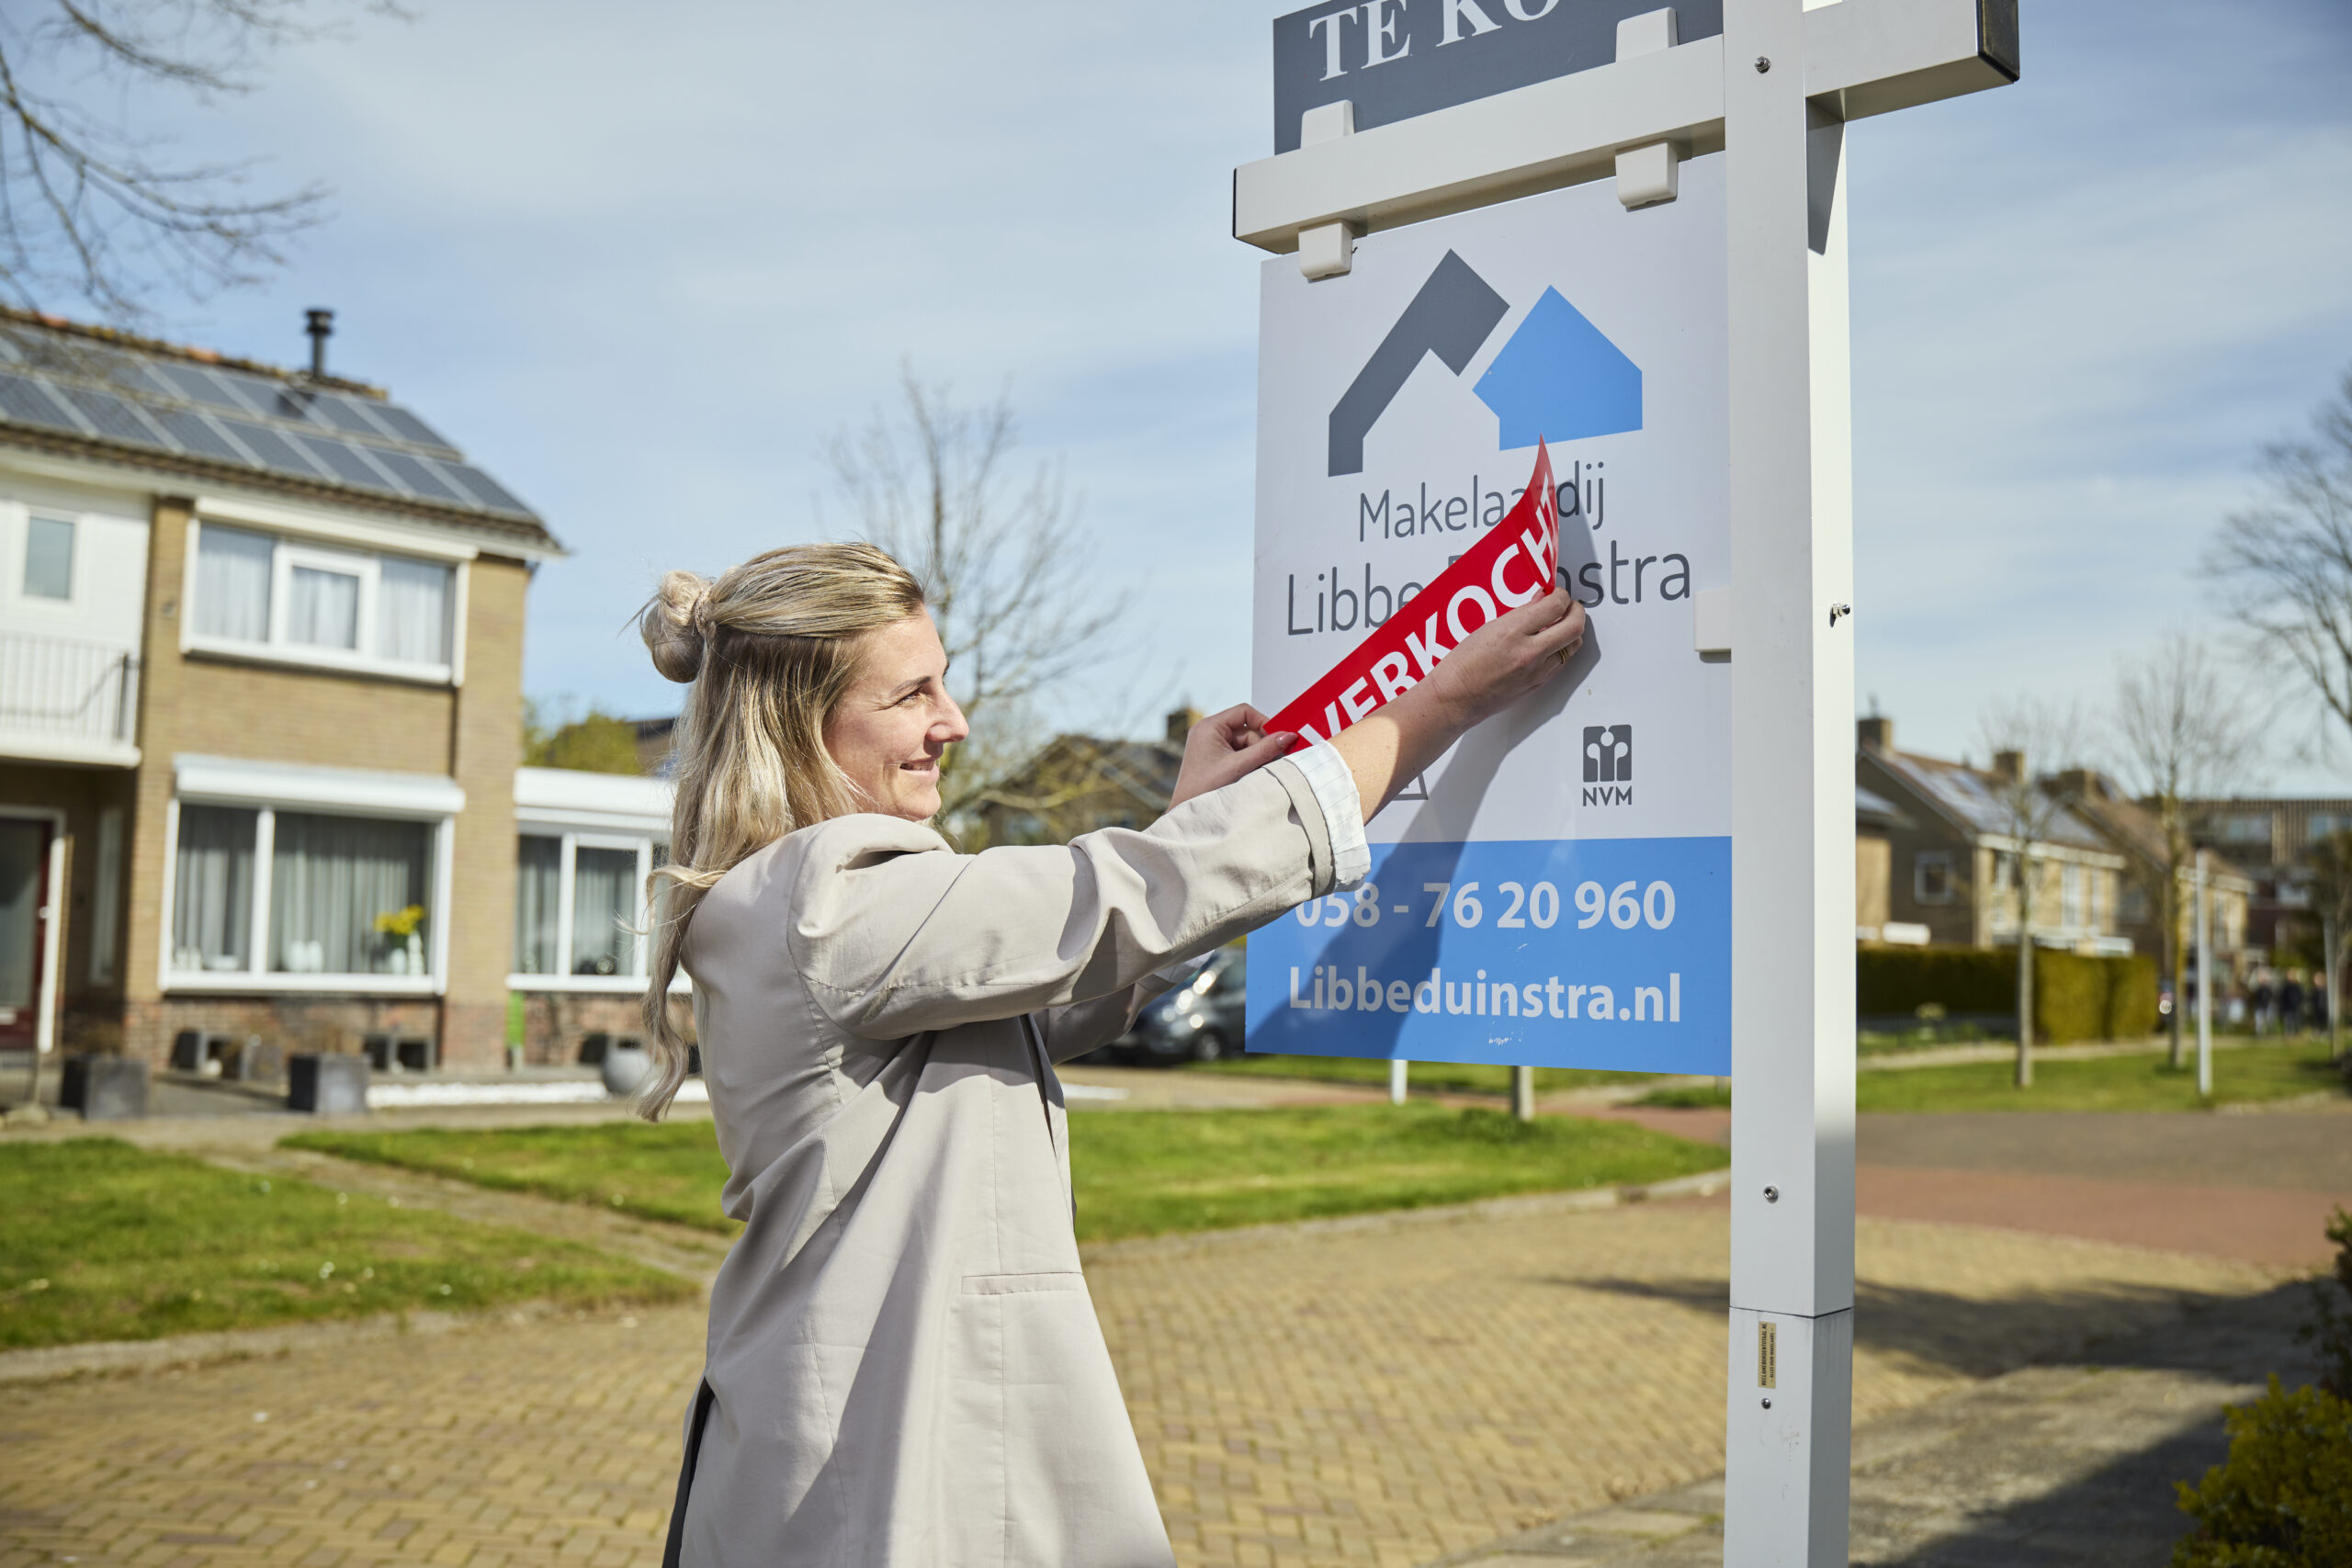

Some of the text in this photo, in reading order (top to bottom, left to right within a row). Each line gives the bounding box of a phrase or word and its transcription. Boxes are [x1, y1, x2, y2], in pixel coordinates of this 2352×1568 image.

[1309, 0, 1410, 81] TE
[1360, 460, 1604, 542] Makeladij
[1582, 785, 1633, 807] NVM
[1295, 880, 1676, 931] 058 - 76 20 960
[1289, 964, 1680, 1022] Libbeduinstra.nl
